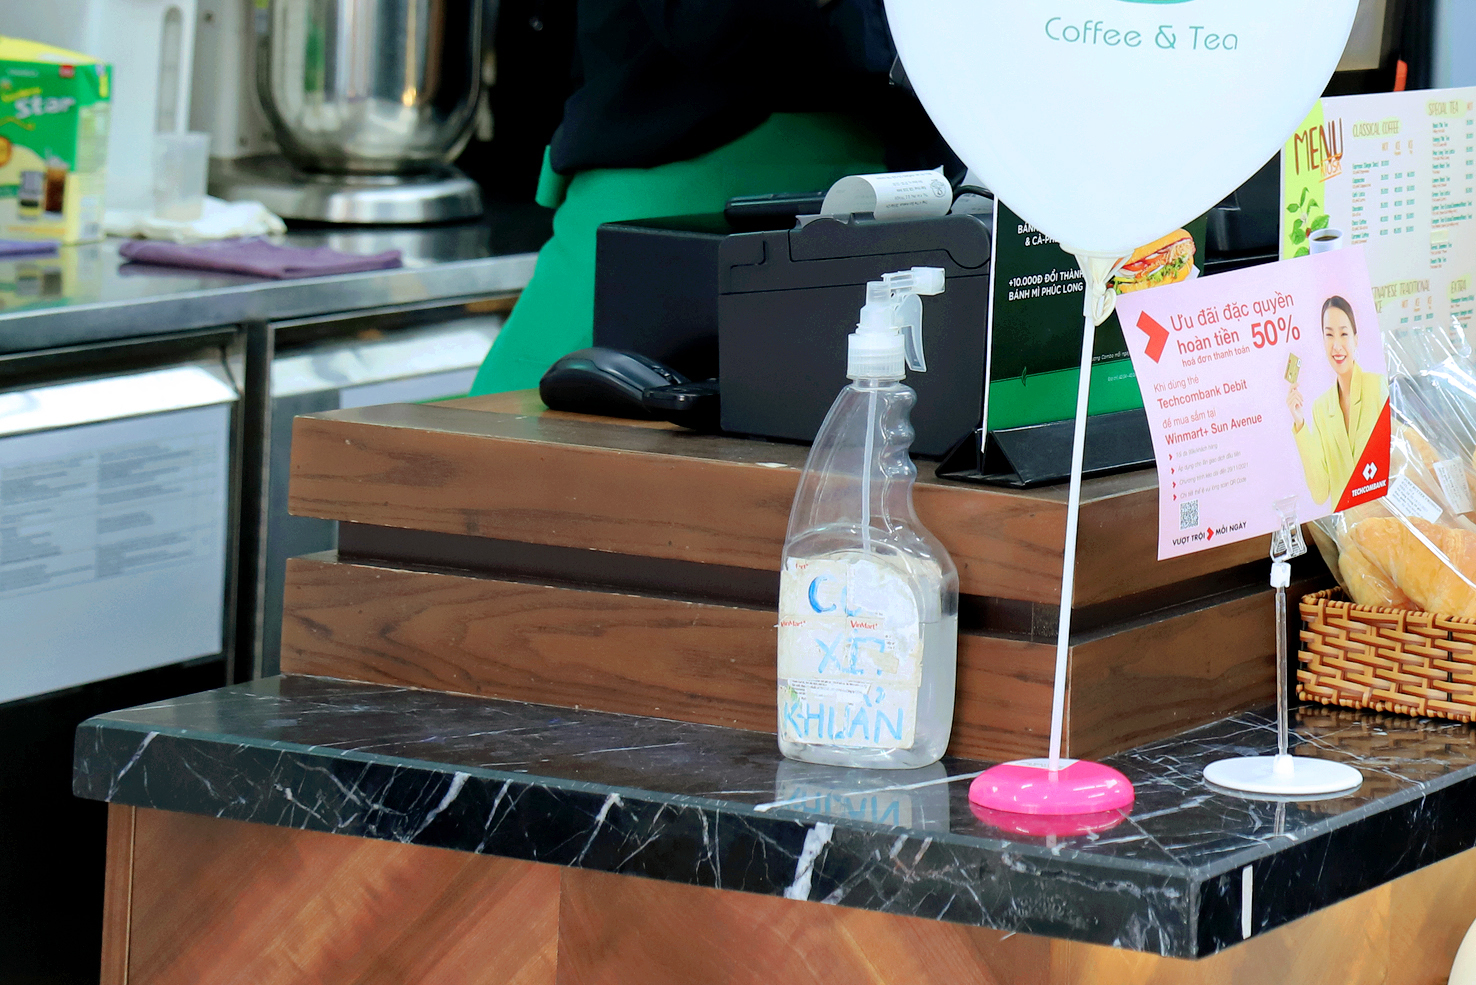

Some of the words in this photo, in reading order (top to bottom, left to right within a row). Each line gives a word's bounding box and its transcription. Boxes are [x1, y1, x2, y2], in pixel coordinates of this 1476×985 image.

[1045, 17, 1142, 48] Coffee
[1155, 25, 1177, 50] &
[1188, 25, 1238, 50] Tea
[1293, 117, 1344, 176] MENU
[1025, 236, 1031, 247] &
[1008, 274, 1043, 288] +10.000Đ
[1044, 268, 1058, 284] ĐỔI
[1008, 288, 1030, 301] BÁNH
[1031, 286, 1040, 298] MÌ
[1041, 283, 1062, 296] PHÚC
[1062, 281, 1084, 294] LONG
[1169, 310, 1194, 332] Ưu
[1197, 306, 1220, 327] đãi
[1222, 302, 1250, 324] đặc
[1252, 290, 1295, 317] quyền
[1176, 333, 1212, 355] hoàn
[1213, 327, 1240, 348] tiền
[1250, 314, 1301, 350] 50%
[1213, 347, 1234, 361] thanh
[1234, 344, 1251, 357] toán
[1153, 382, 1166, 394] Khi
[1167, 377, 1186, 392] dùng
[1157, 386, 1222, 410] Techcombank
[1222, 379, 1248, 396] Debit
[1165, 427, 1209, 446] Winmart+
[1210, 421, 1229, 435] Sun
[1230, 412, 1263, 431] Avenue
[1173, 414, 1191, 427] mua
[1351, 479, 1387, 498] TECHCOMBANK
